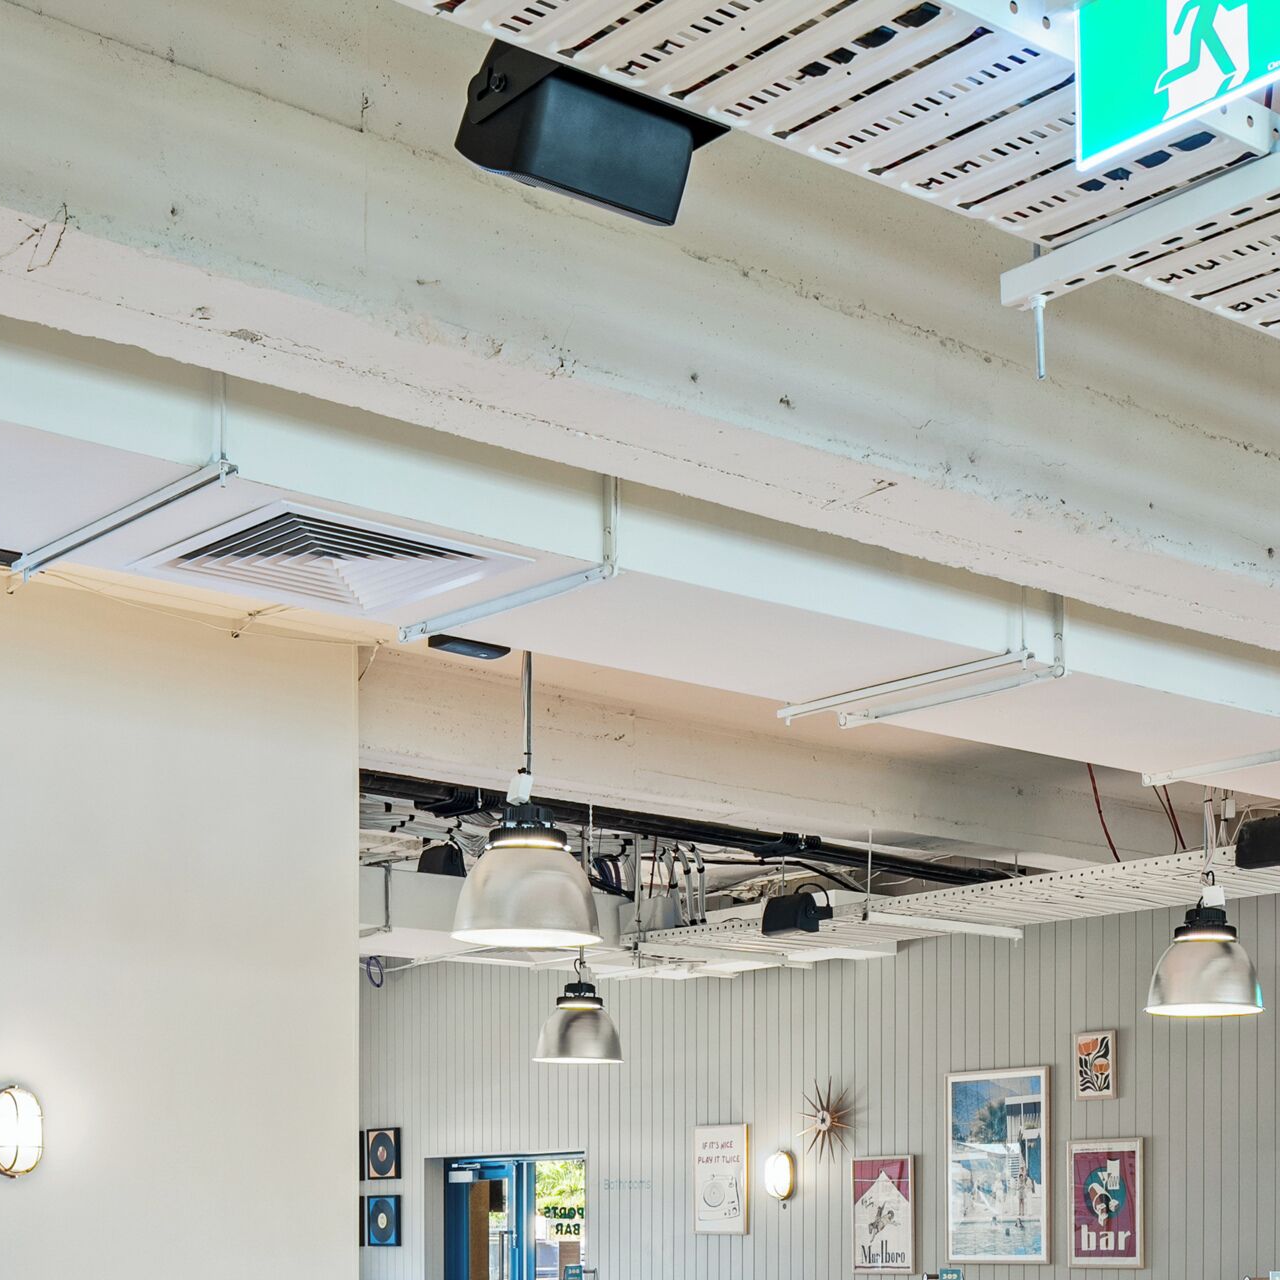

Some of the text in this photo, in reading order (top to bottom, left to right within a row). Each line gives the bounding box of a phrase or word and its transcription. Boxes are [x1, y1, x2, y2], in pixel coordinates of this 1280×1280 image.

[702, 1142, 708, 1150] IF
[720, 1140, 734, 1150] NICE
[698, 1156, 713, 1164] PLAY
[722, 1155, 740, 1164] TWICE
[1080, 1224, 1132, 1251] bar
[861, 1240, 906, 1264] Marlboro
